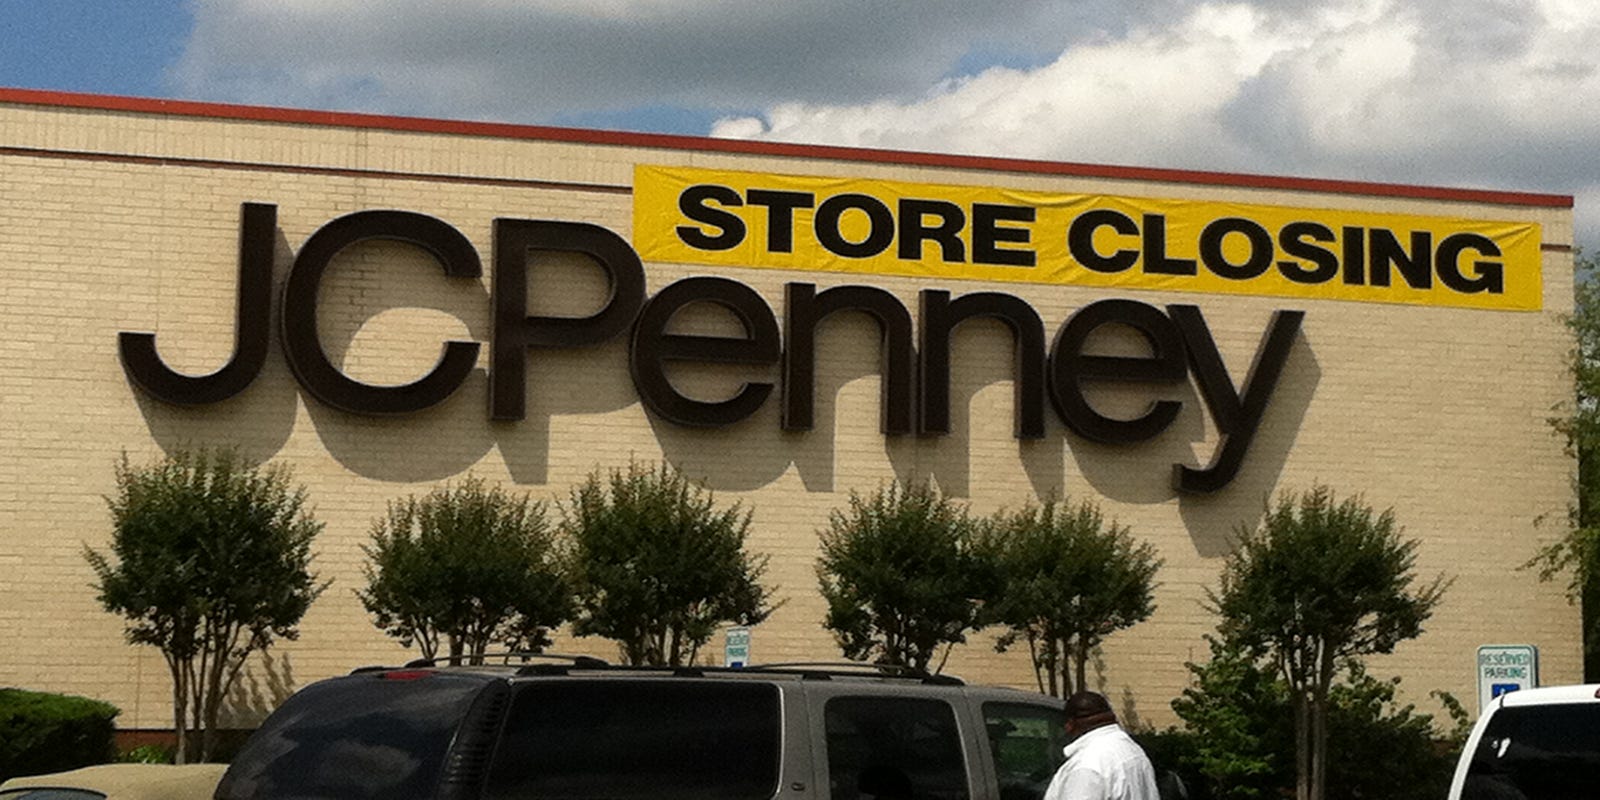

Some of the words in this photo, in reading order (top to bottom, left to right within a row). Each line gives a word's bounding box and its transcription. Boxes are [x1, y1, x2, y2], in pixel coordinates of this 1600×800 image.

[676, 184, 1036, 267] STORE
[1067, 209, 1504, 294] CLOSING
[118, 202, 1305, 493] JCPenney
[1480, 653, 1530, 666] RESERVED
[1484, 667, 1528, 679] PARKING
